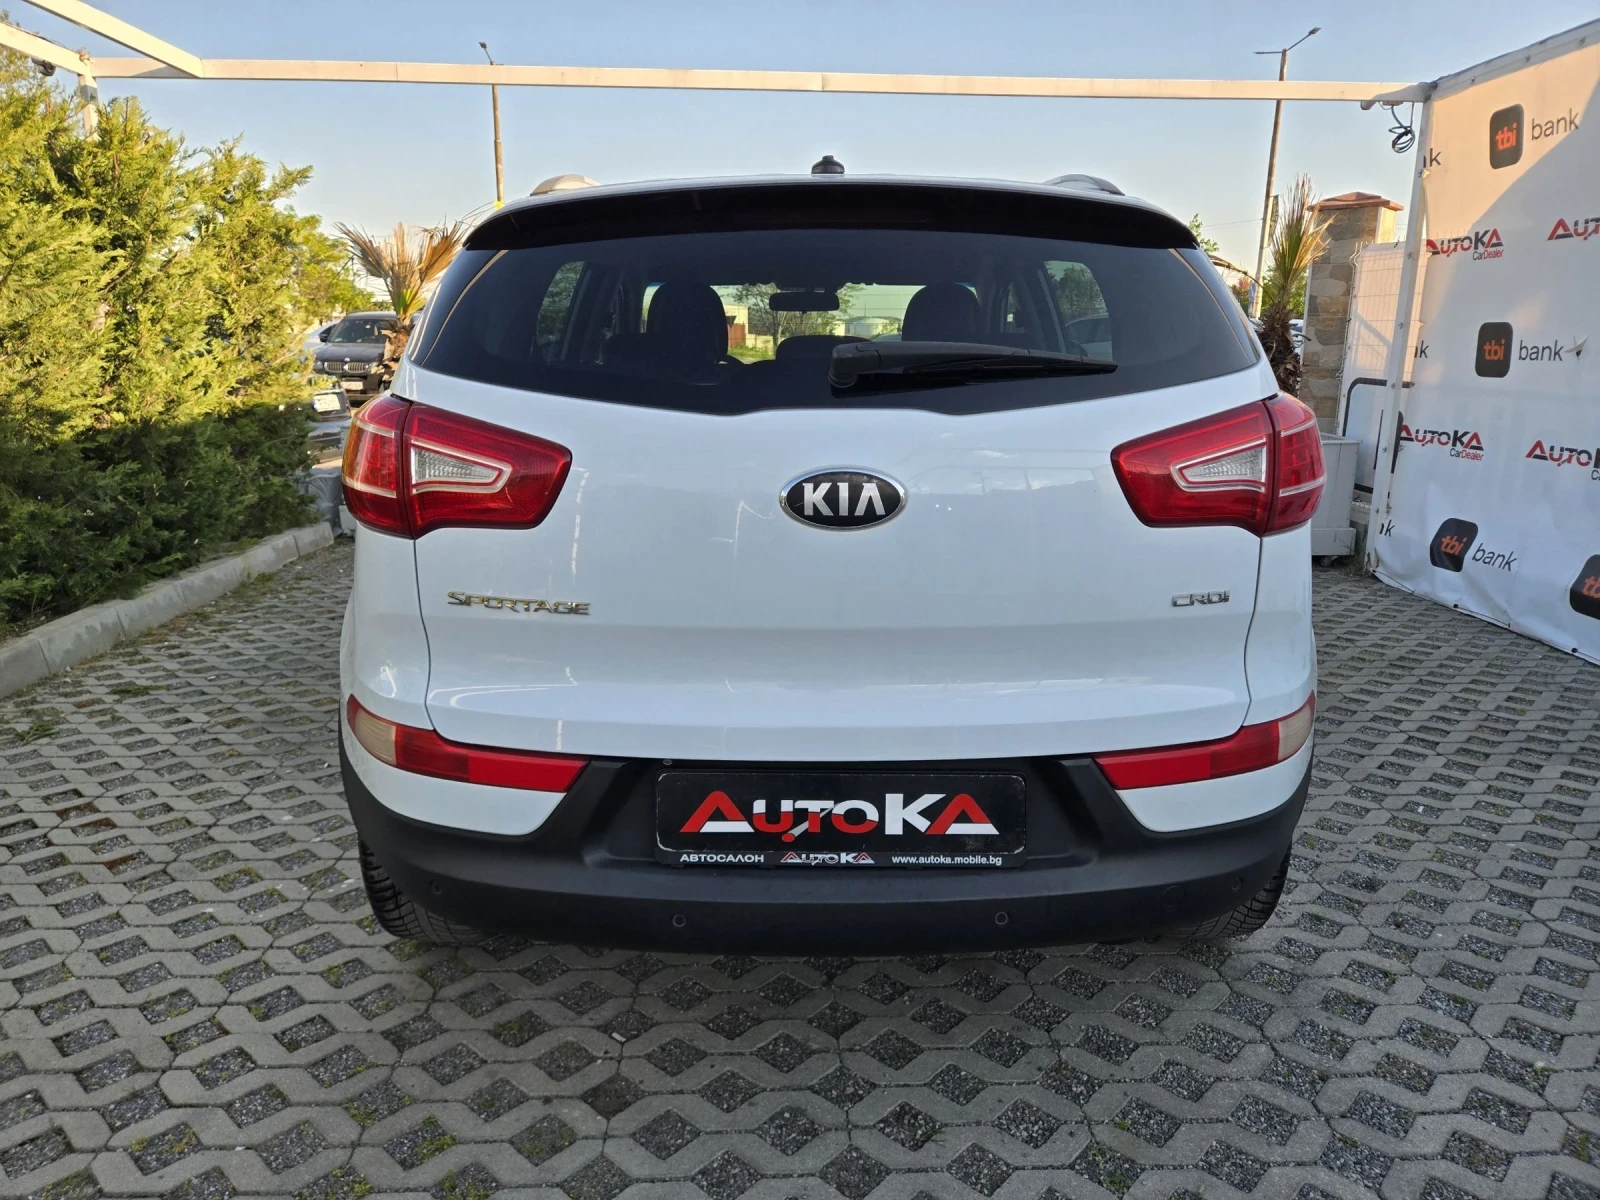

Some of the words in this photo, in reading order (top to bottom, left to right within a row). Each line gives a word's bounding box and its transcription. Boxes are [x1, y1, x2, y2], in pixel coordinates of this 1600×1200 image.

[1495, 121, 1518, 150] tbi
[1531, 107, 1579, 141] bank
[1483, 338, 1506, 361] tbi
[1518, 339, 1564, 362] bank
[802, 482, 886, 516] KIA
[1440, 535, 1467, 556] tbi
[1471, 543, 1518, 572] bank
[446, 590, 592, 616] SPORTAGE
[679, 853, 765, 864] АВТОСАЛОН
[891, 853, 1003, 867] www.autoka.mobile.bg
